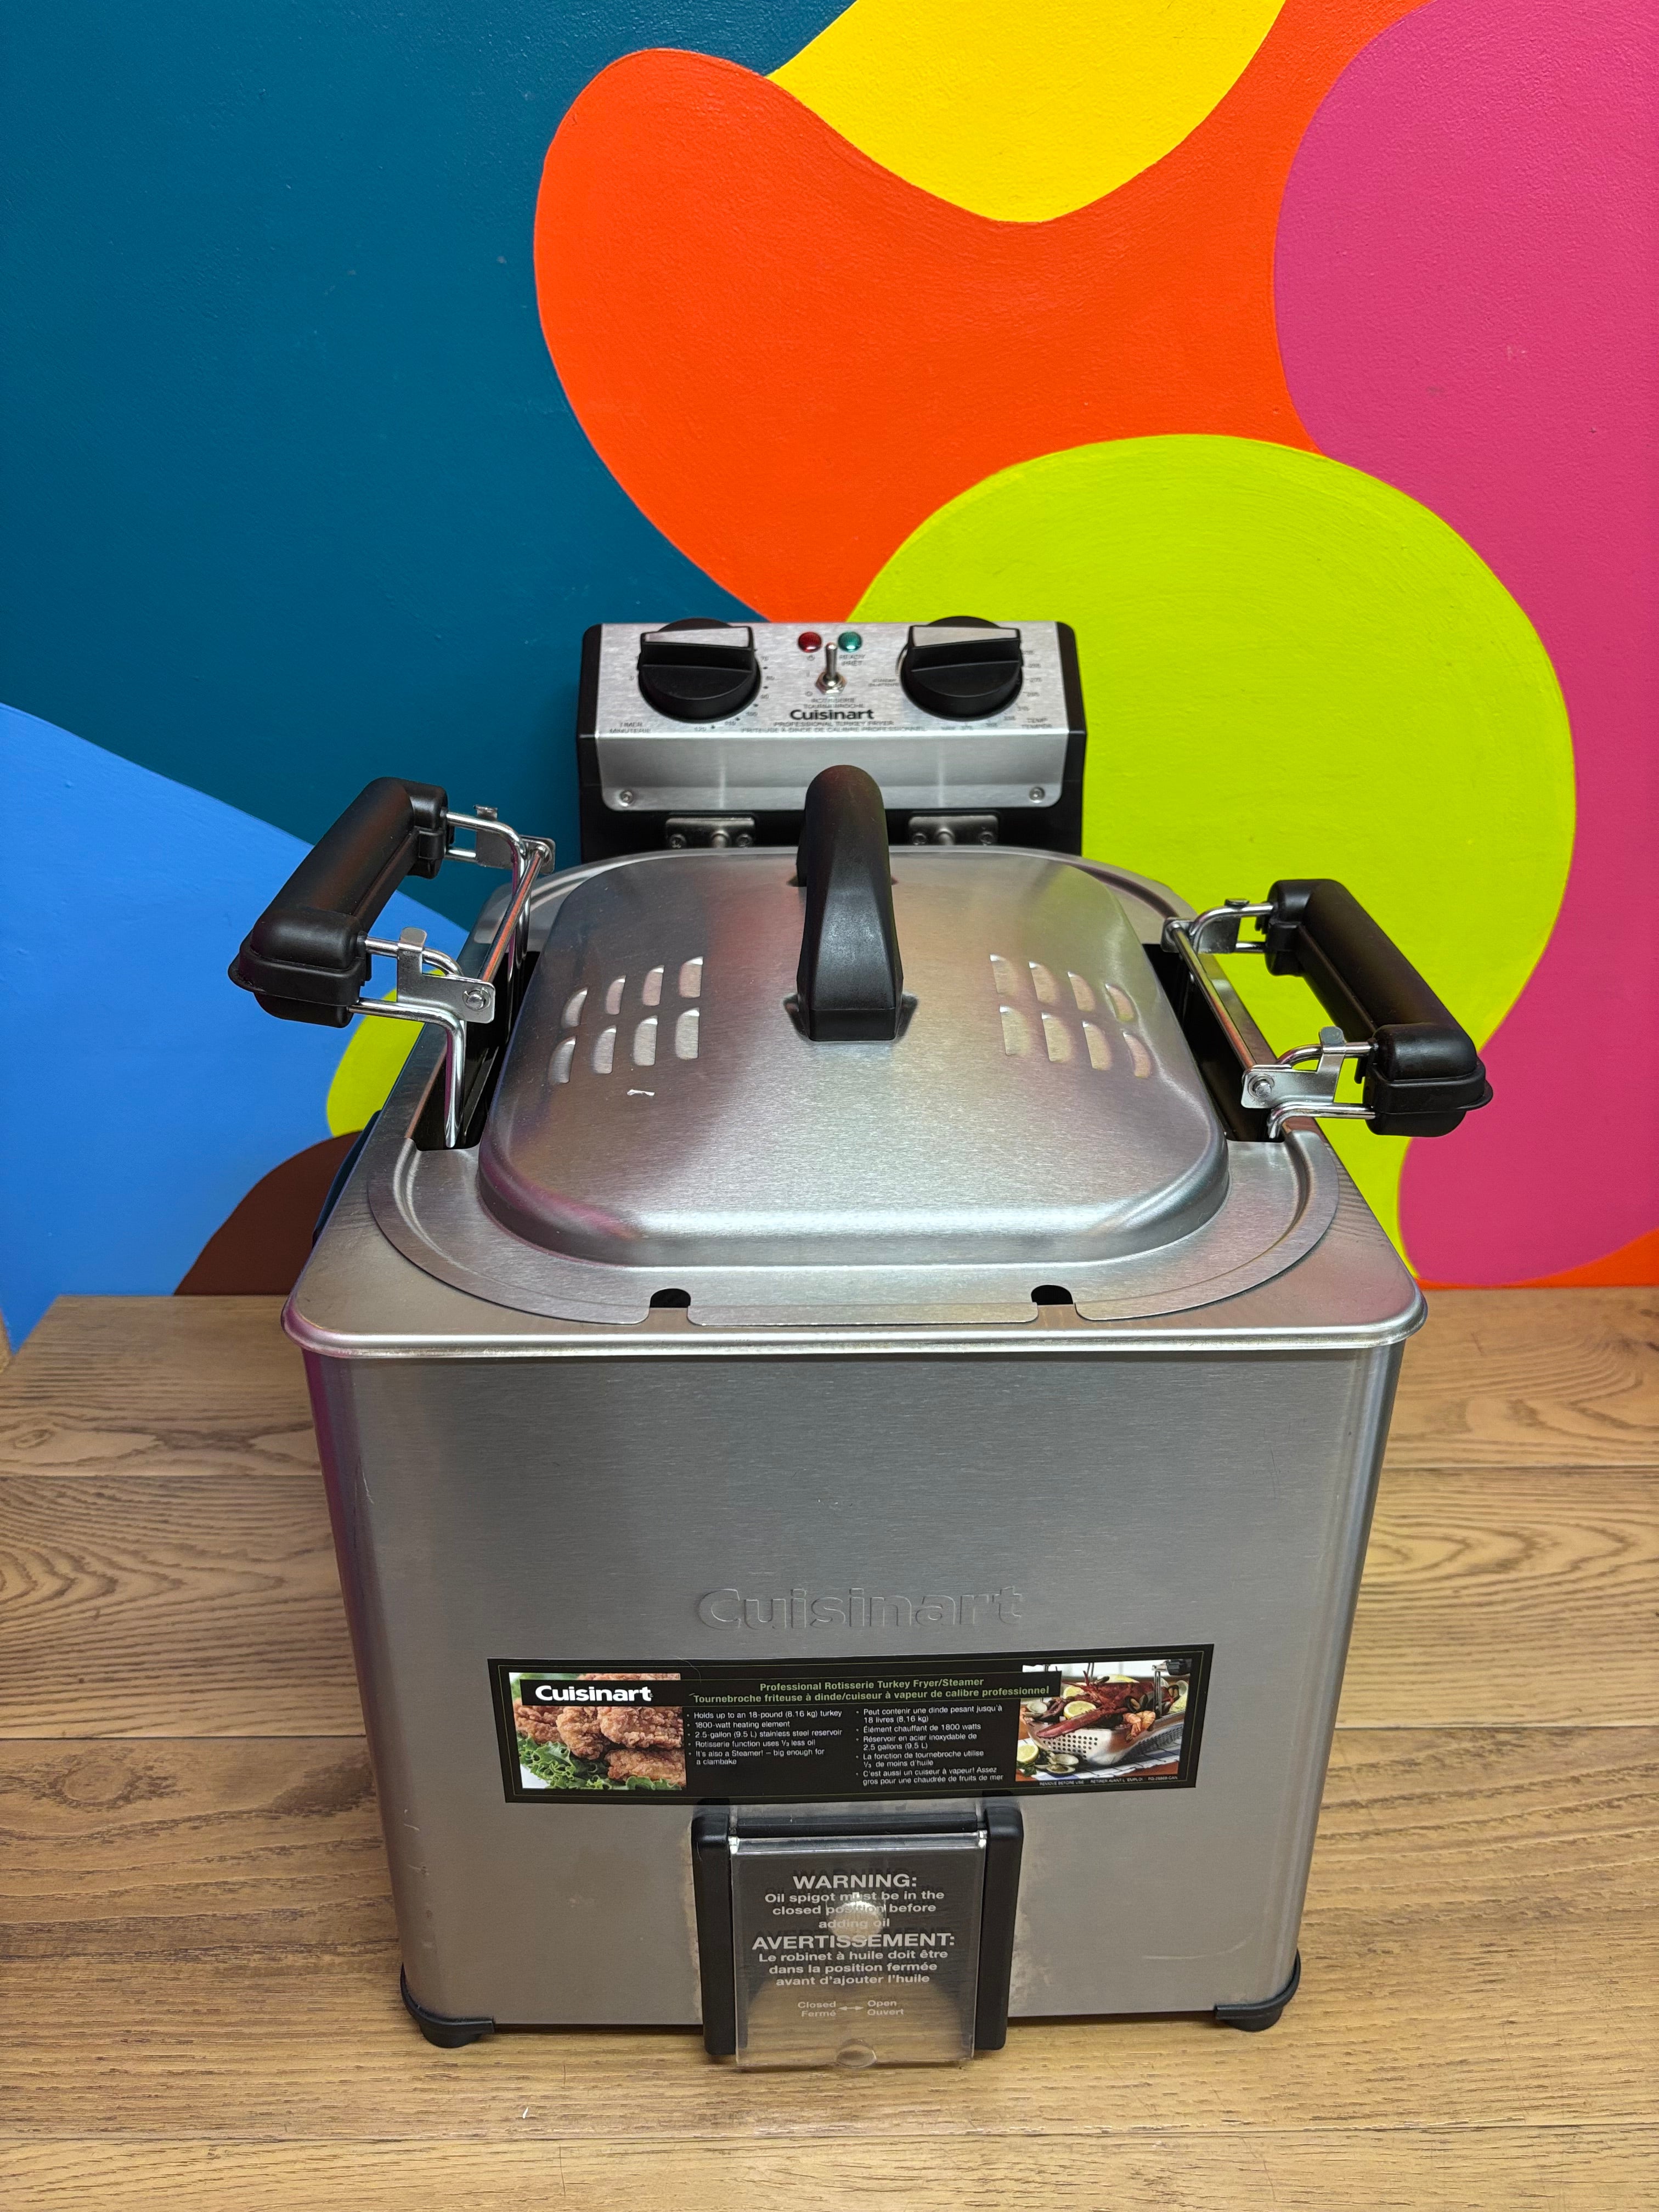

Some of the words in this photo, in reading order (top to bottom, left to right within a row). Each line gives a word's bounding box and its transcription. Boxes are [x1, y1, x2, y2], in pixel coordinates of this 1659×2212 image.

[790, 709, 874, 720] Cuisinart
[697, 1587, 1022, 1631] Cuisinart
[760, 1682, 821, 1691] Professional
[825, 1681, 874, 1690] Rotisserie
[877, 1680, 910, 1690] Turkey
[913, 1679, 984, 1689] Fryer/Steamer
[535, 1685, 652, 1701] Cuisinart
[693, 1694, 761, 1703] Tournebroche
[815, 1692, 882, 1701] dinde/cuiseur
[885, 1691, 890, 1699] à
[894, 1692, 928, 1700] vapeur
[930, 1689, 942, 1697] de
[945, 1689, 979, 1697] calibre
[982, 1686, 1049, 1697] professionnel
[929, 1733, 966, 1741] inoxydable
[877, 1743, 902, 1751] gallons
[949, 1767, 975, 1775] vapeur!
[793, 1874, 917, 1889] WARNING:
[765, 1894, 785, 1903] Oil
[789, 1893, 835, 1903] spigot
[881, 1892, 899, 1900] be
[904, 1891, 916, 1900] in
[921, 1891, 945, 1899] the
[772, 1905, 821, 1915] closed
[889, 1904, 936, 1912] before
[819, 1920, 868, 1929] adding
[873, 1918, 889, 1927] oil
[752, 1933, 955, 1950] AVERTISSEMENT:
[759, 1954, 776, 1962] Le
[781, 1953, 832, 1961] robinet
[836, 1951, 845, 1960] à
[849, 1951, 883, 1960] huile
[888, 1950, 916, 1959] doit
[920, 1949, 948, 1959] être
[769, 1965, 804, 1974] dans
[808, 1965, 821, 1973] la
[825, 1963, 882, 1974] position
[887, 1962, 937, 1971] fermée
[776, 1977, 815, 1985] avant
[820, 1976, 884, 1985] d'ajouter
[888, 1974, 930, 1983] l'huile
